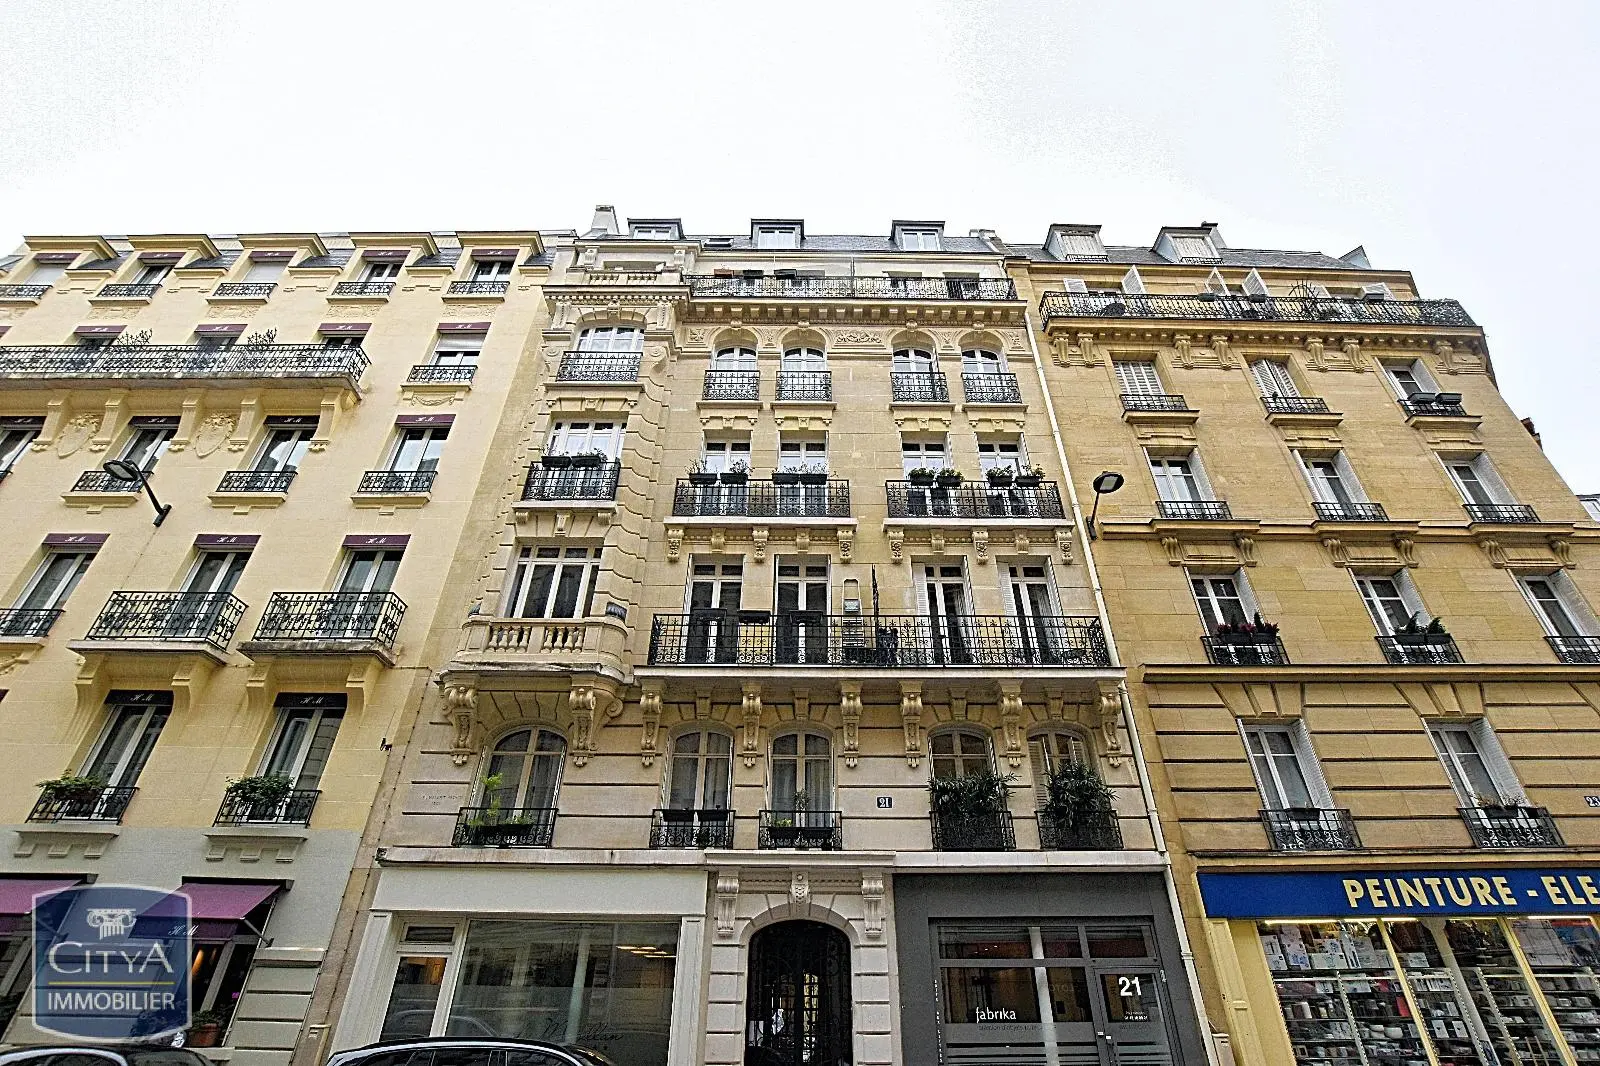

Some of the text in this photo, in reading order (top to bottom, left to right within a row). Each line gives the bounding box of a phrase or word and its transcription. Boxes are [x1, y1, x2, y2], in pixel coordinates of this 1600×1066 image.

[879, 797, 890, 808] 21
[1343, 876, 1518, 908] PEINTURE
[1118, 976, 1142, 997] 21
[975, 1006, 1017, 1024] fabrika
